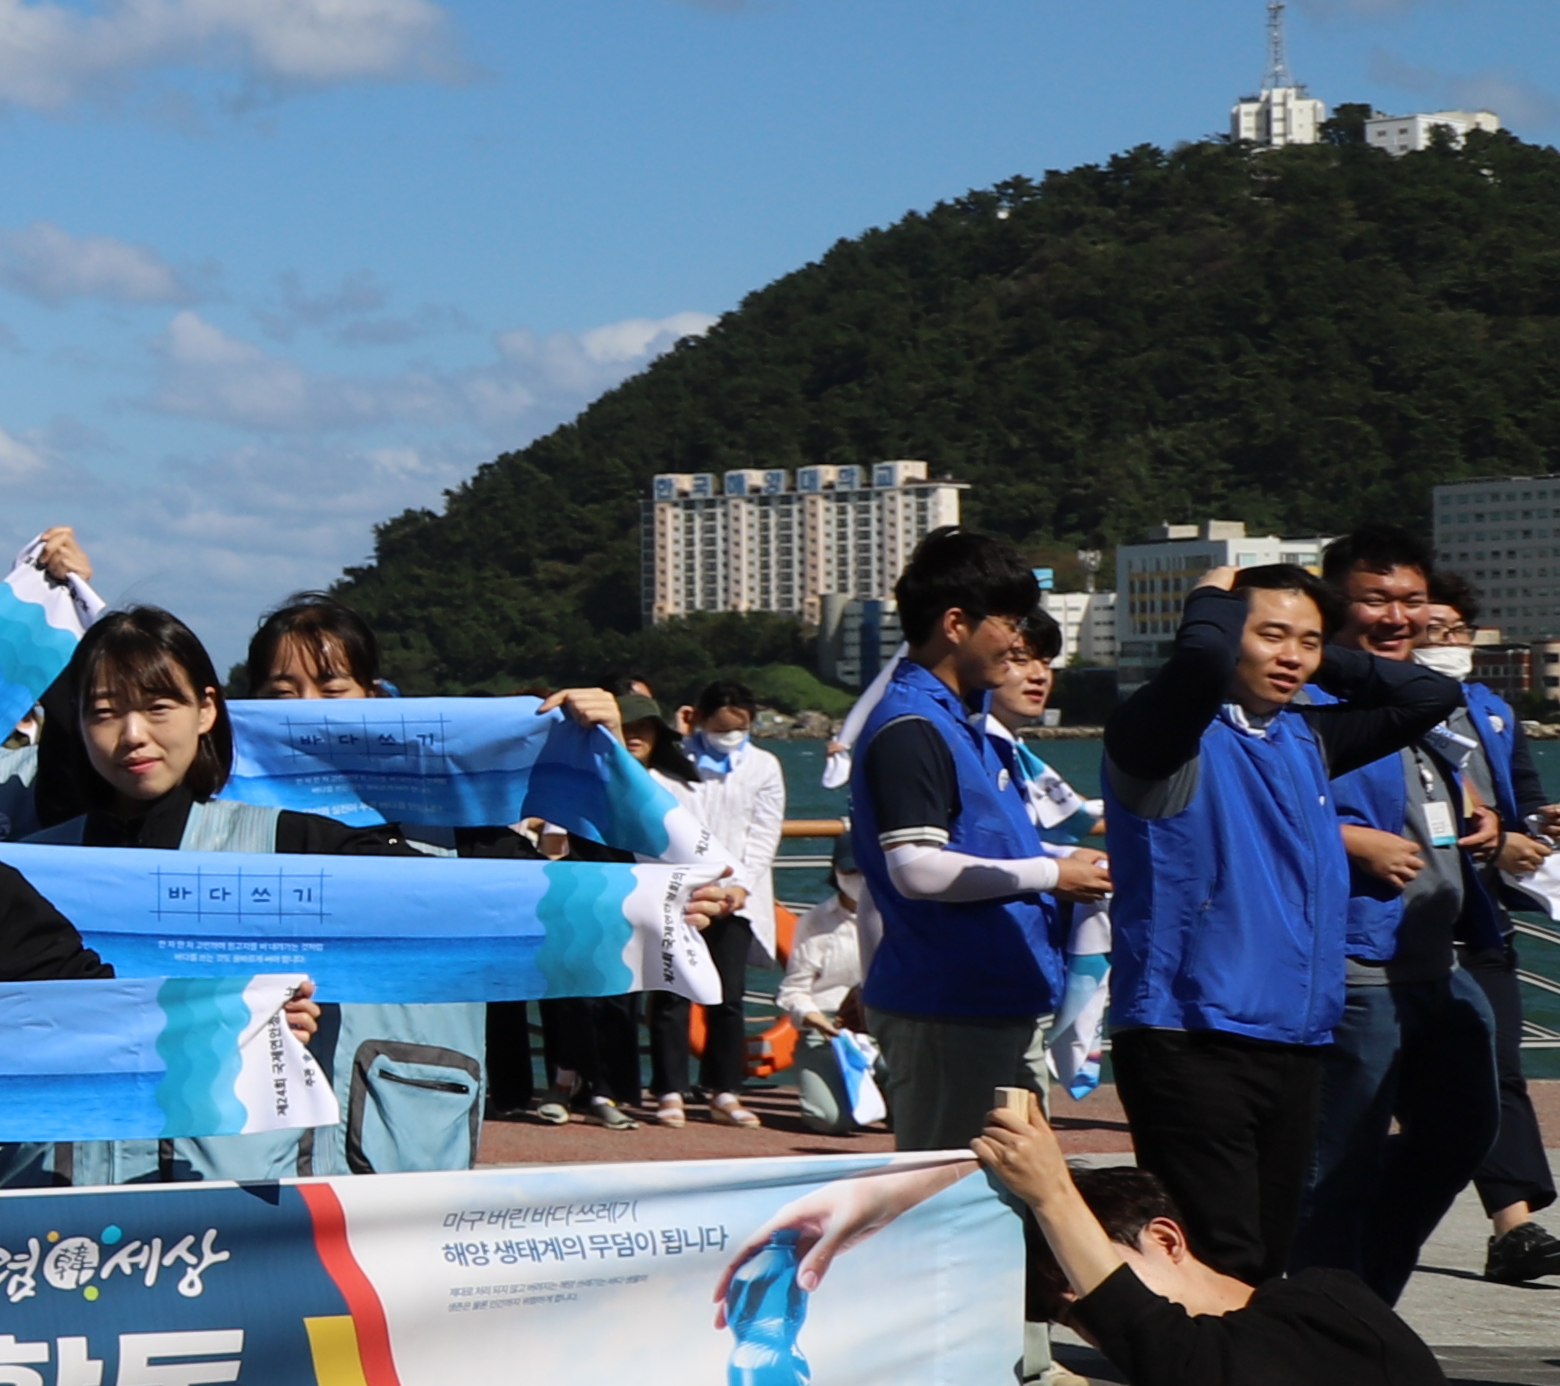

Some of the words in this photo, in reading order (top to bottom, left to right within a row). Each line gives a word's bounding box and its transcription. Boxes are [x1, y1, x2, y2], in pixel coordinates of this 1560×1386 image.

[442, 1209, 485, 1232] 마구
[486, 1206, 529, 1230] 버린
[531, 1203, 574, 1228] 바다
[575, 1199, 639, 1225] 쓰레기
[441, 1240, 490, 1267] 해양
[493, 1234, 587, 1265] 생태계의
[589, 1229, 657, 1259] 무덤이
[661, 1224, 730, 1255] 됩니다
